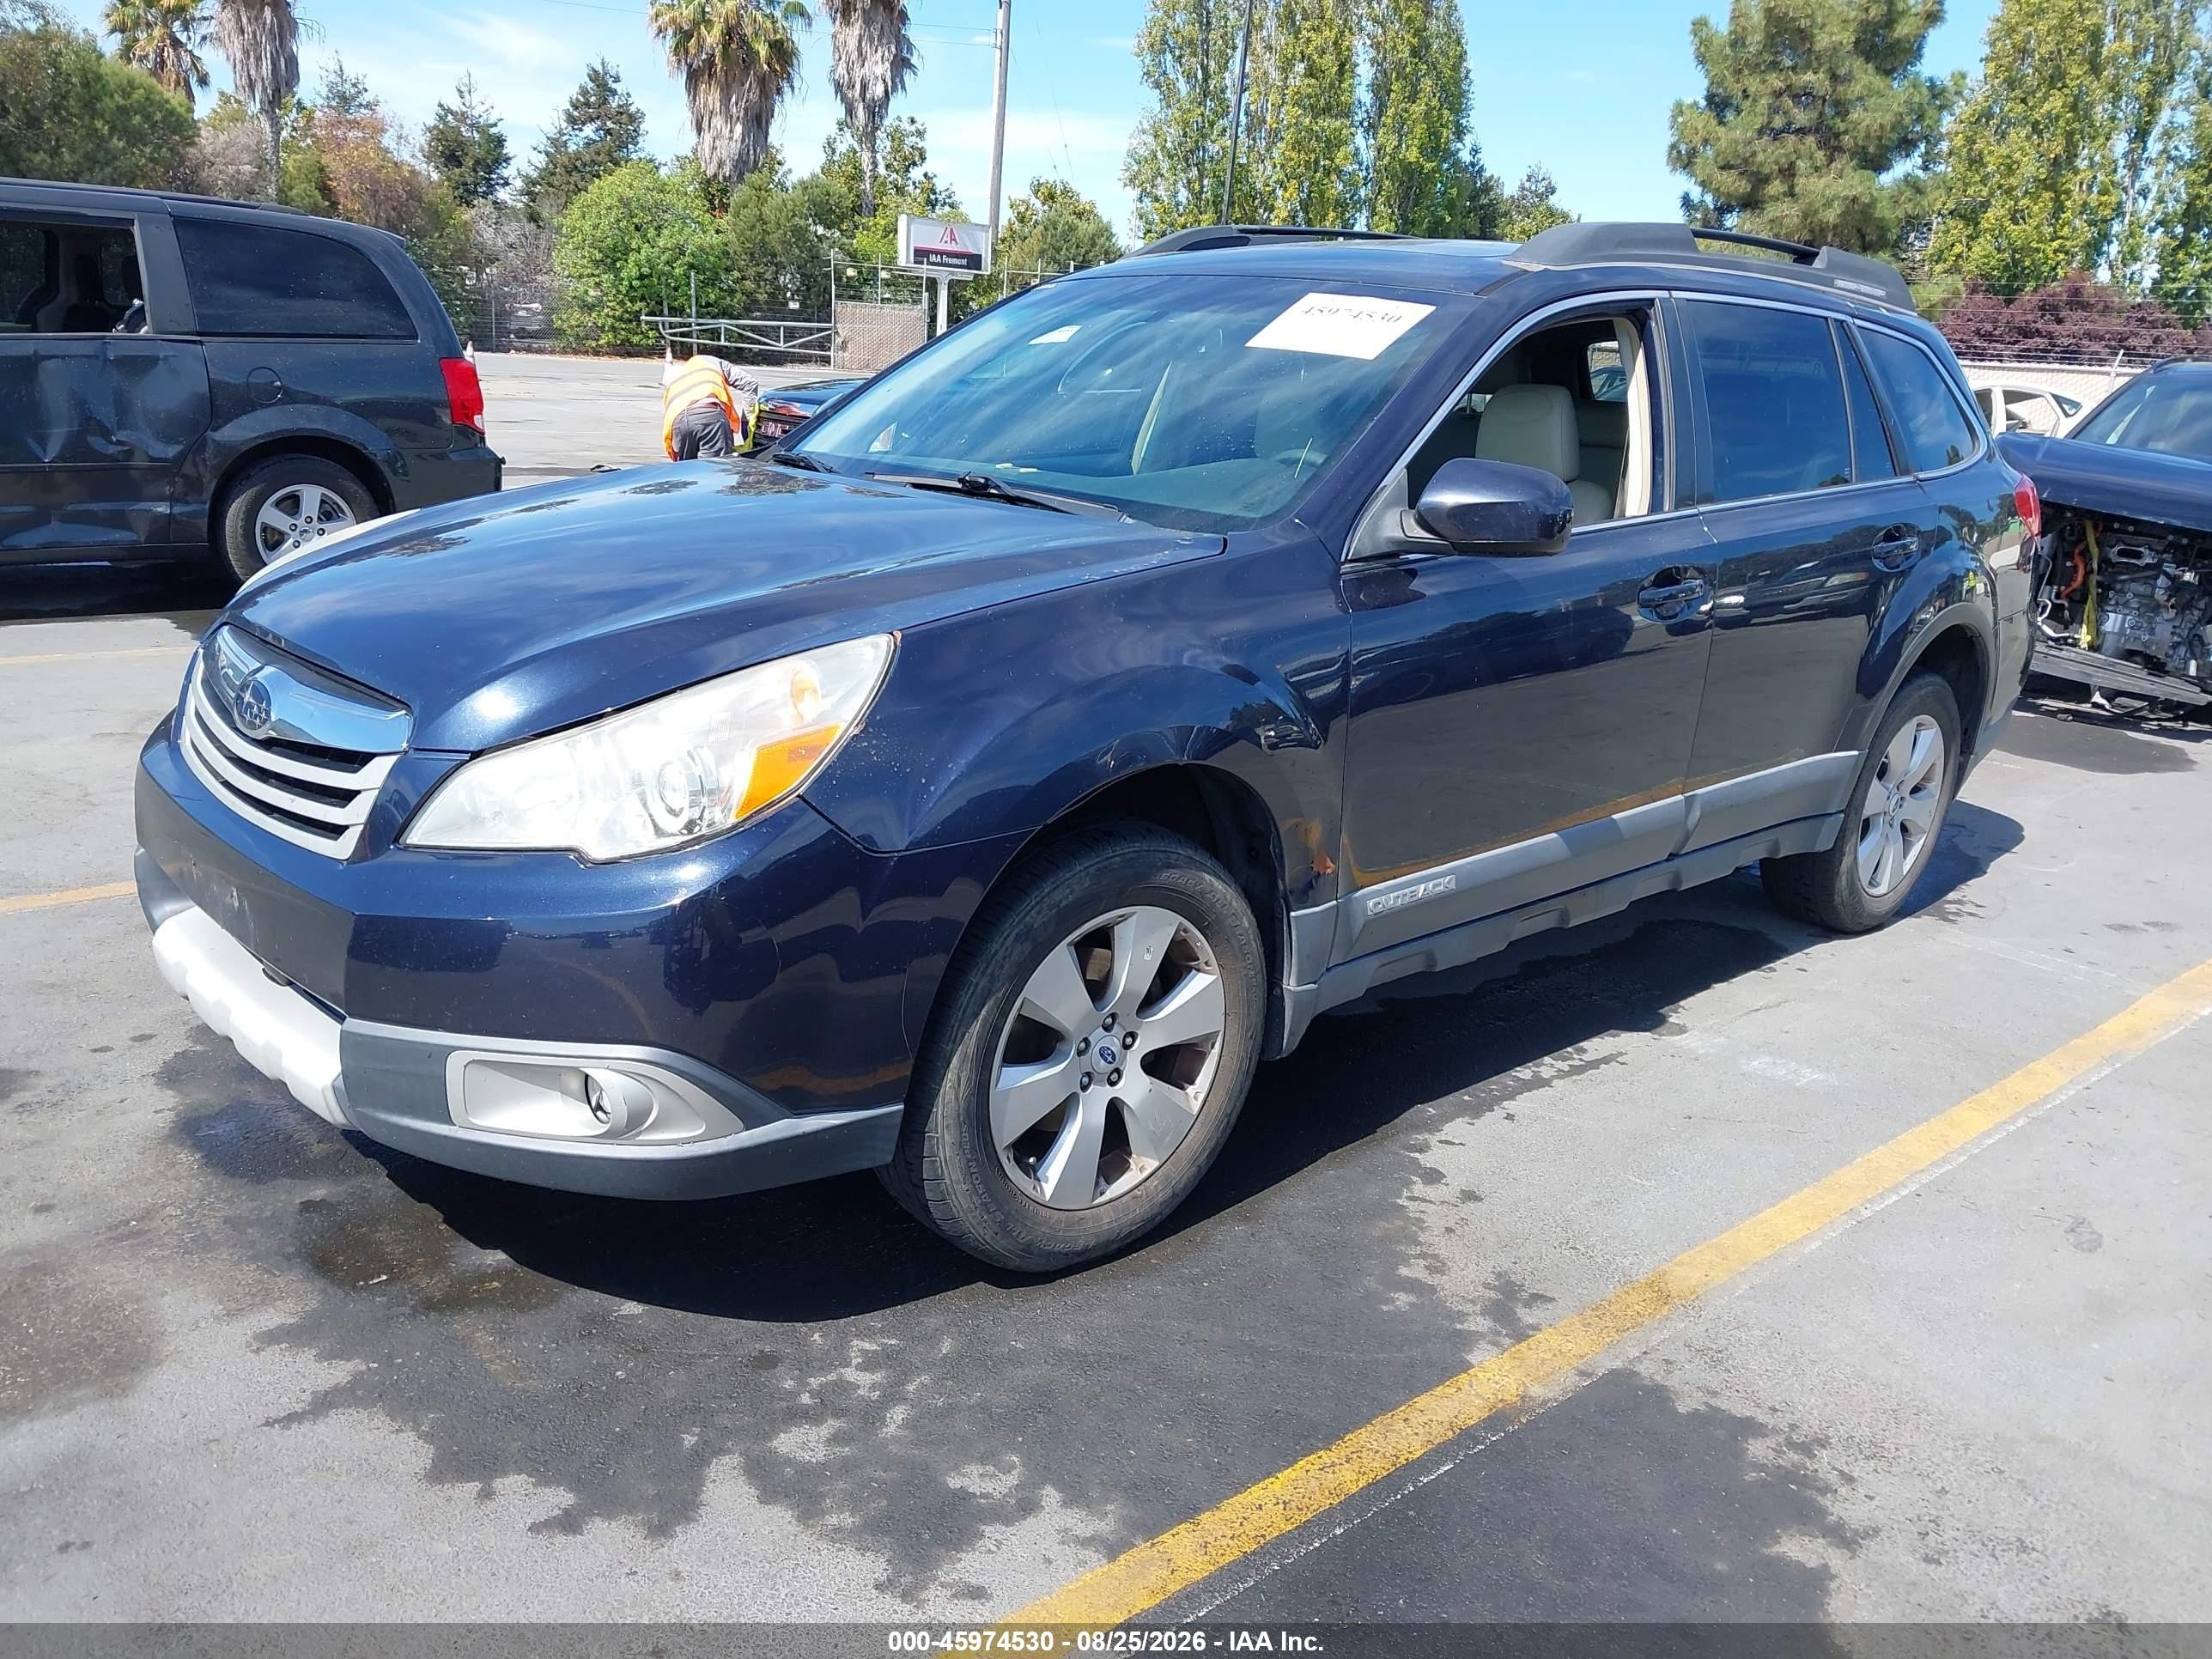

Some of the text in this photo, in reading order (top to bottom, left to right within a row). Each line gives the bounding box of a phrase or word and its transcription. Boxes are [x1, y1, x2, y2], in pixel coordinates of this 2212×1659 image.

[929, 253, 968, 265] IAA Fremont
[1367, 875, 1456, 915] OUTBACK
